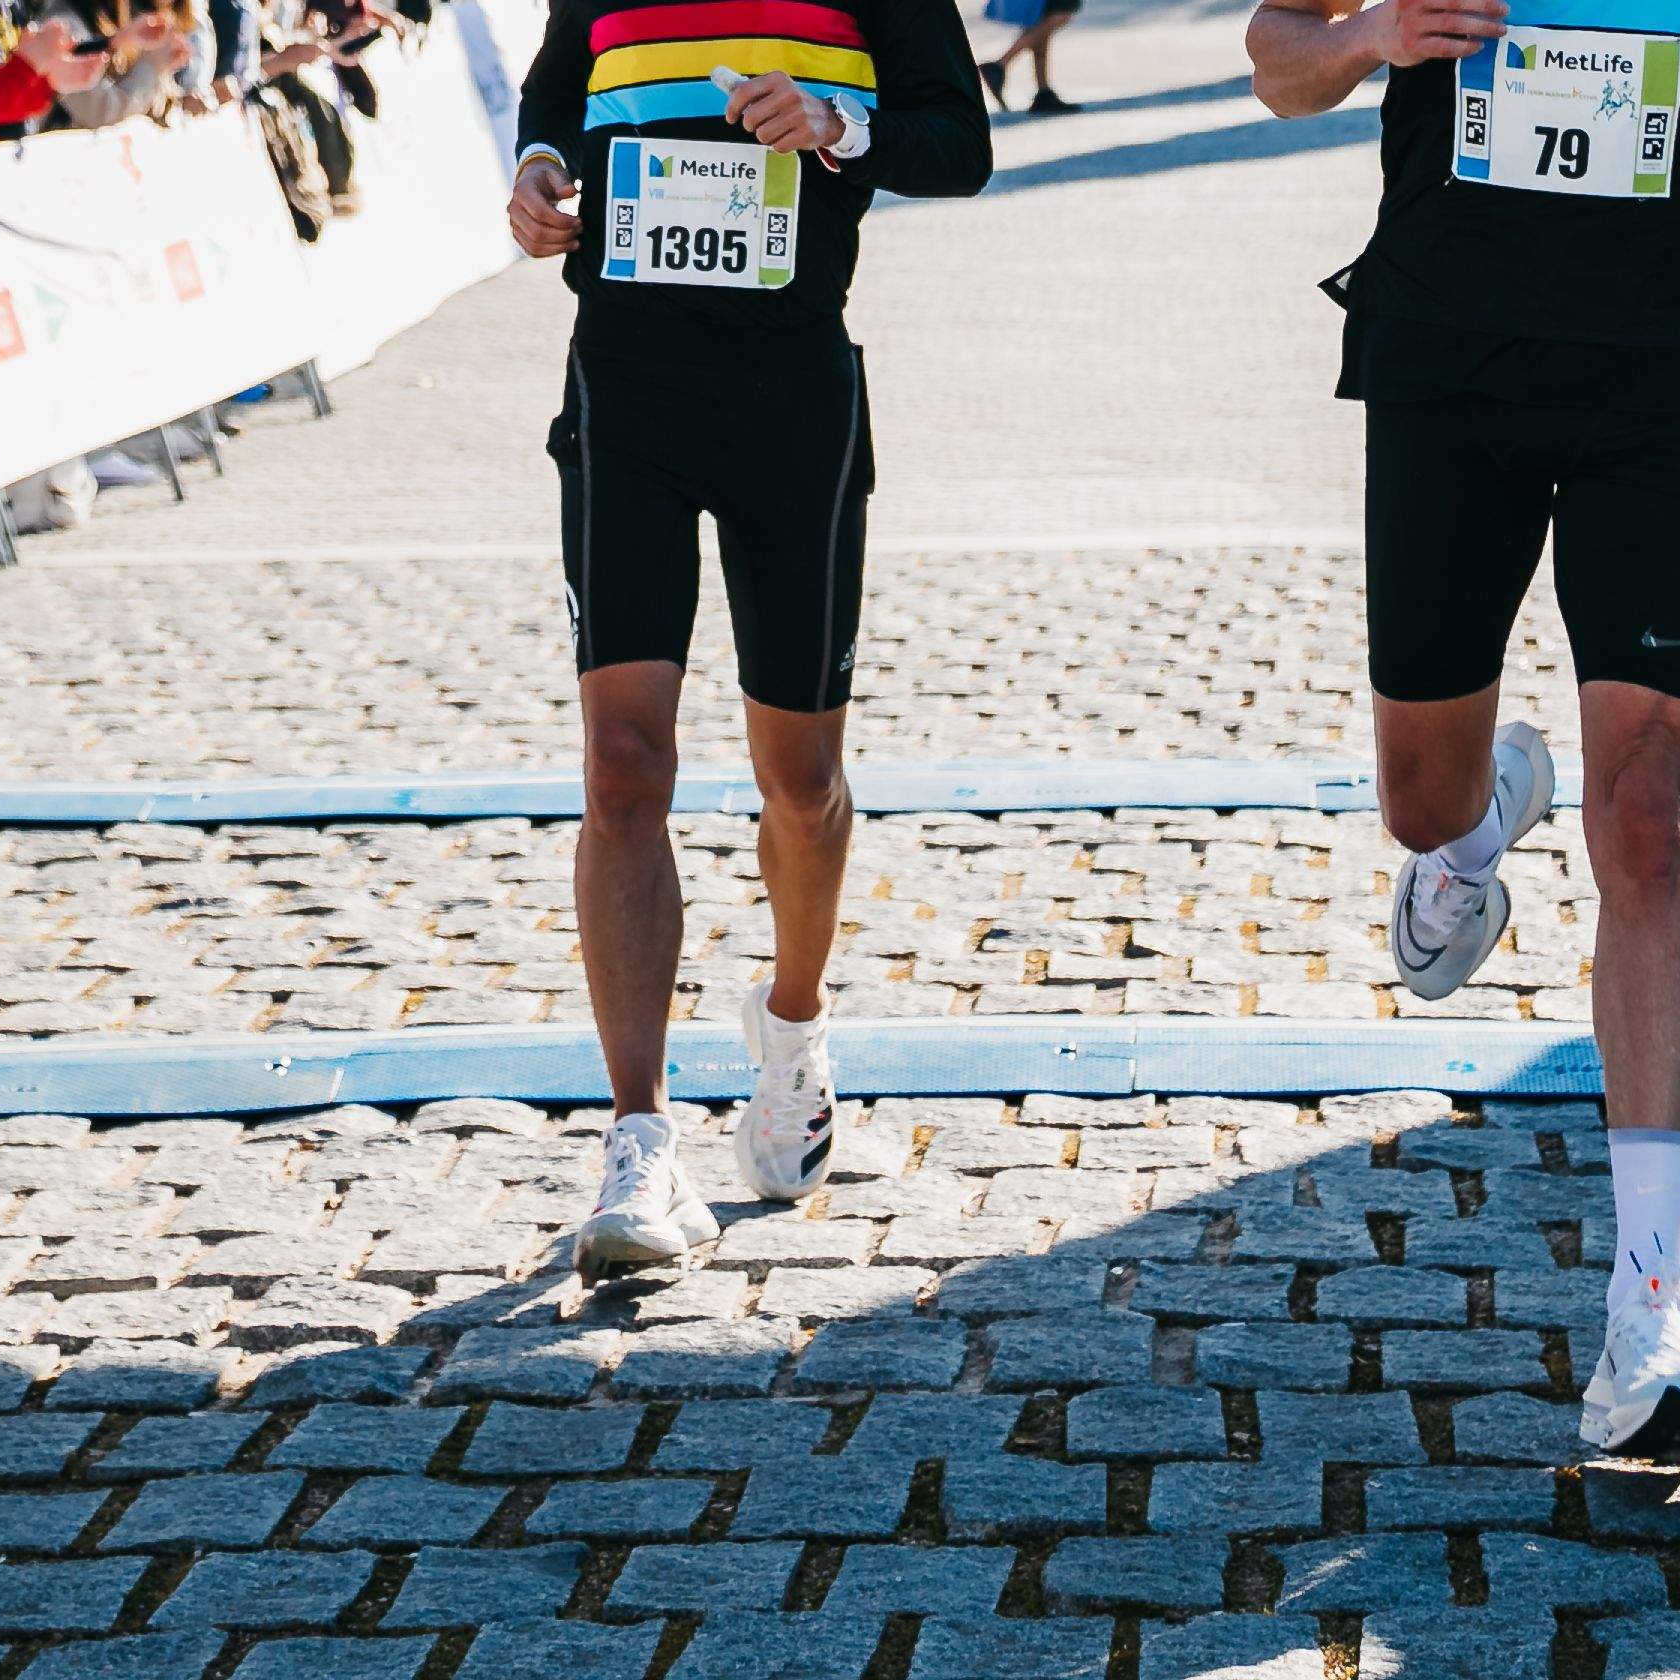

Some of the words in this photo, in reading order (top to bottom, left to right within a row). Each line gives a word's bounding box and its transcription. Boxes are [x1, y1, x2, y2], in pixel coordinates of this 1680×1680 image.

[1544, 49, 1634, 74] MetLife
[680, 159, 757, 181] MetLife
[1534, 126, 1590, 180] 79
[645, 224, 748, 274] 1395
